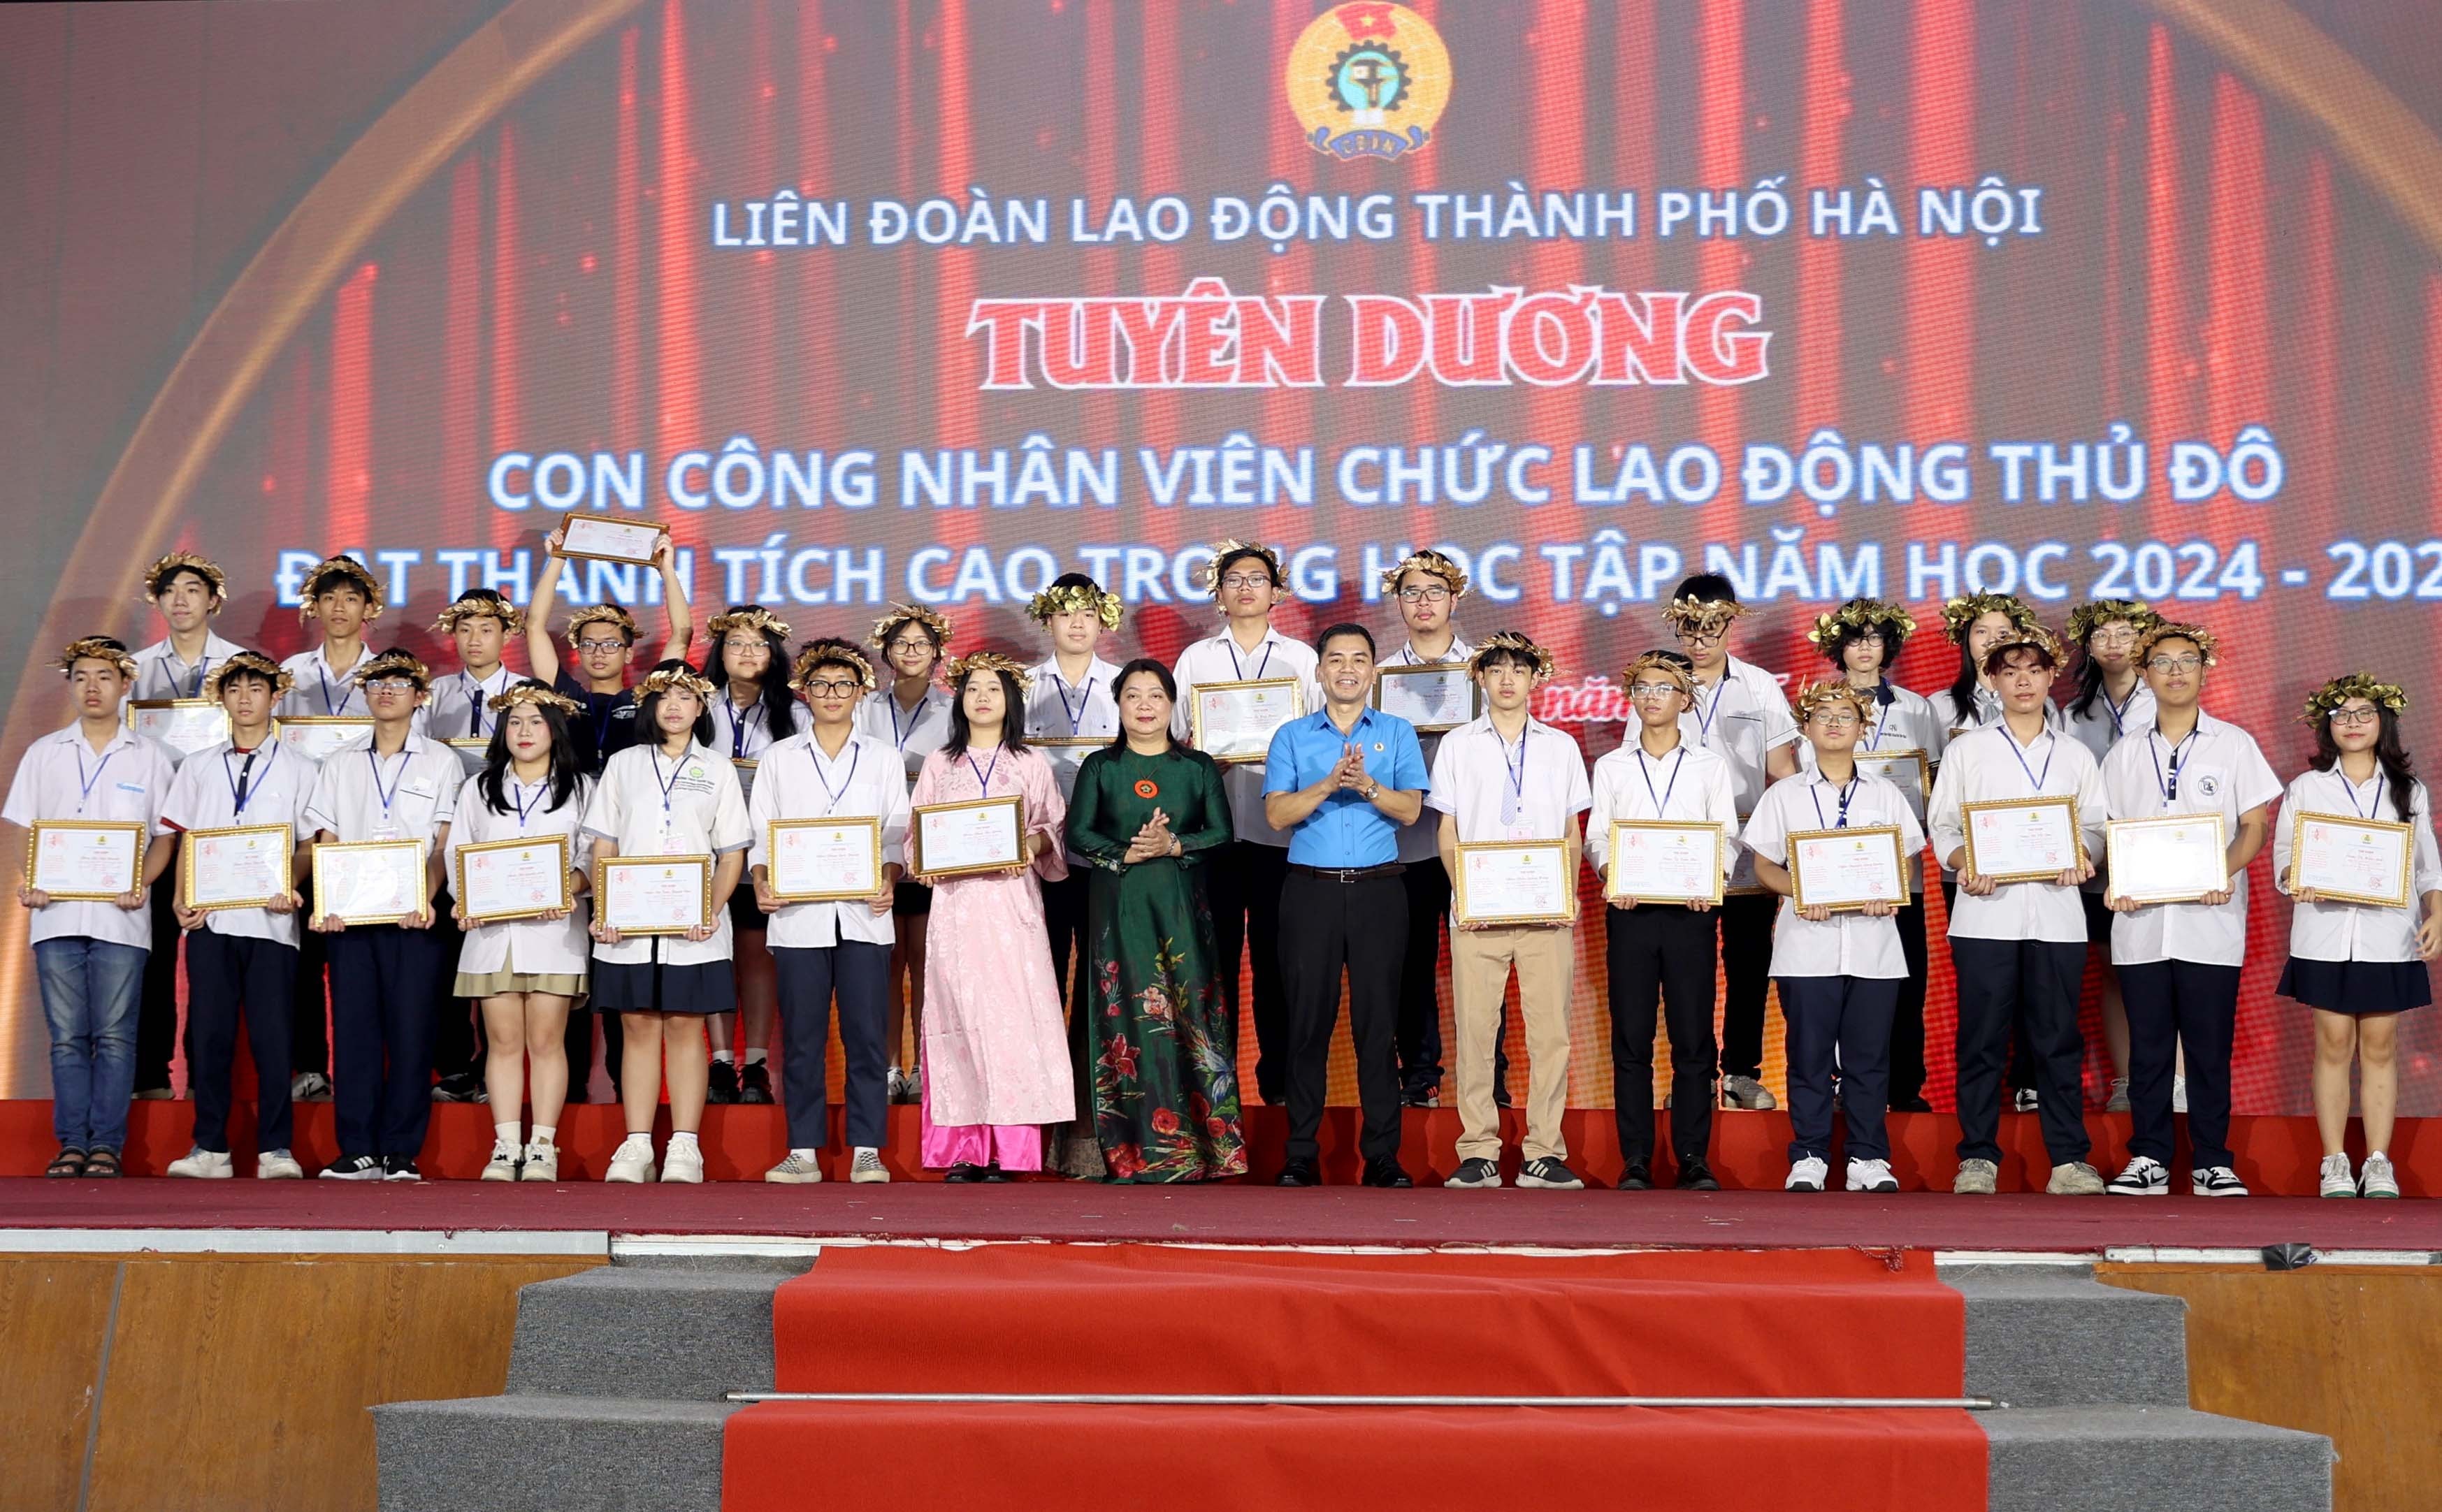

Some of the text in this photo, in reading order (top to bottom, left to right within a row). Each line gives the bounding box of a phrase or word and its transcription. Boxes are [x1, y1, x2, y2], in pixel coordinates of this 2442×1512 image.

[714, 176, 2042, 253] LIÊN ĐOÀN LAO ĐỘNG THÀNH PHỐ HÀ NỘI
[965, 276, 1774, 391] TUYÊN DƯƠNG
[491, 424, 2283, 516] CON CÔNG NHÂN VIÊN CHỨC LAO ĐỘNG THỦ ĐÔ
[275, 551, 419, 605] ĐT
[716, 533, 882, 604] TÍCH
[908, 547, 1057, 603] CAO
[1078, 545, 1338, 602] TROG
[1364, 545, 1522, 601] HC
[1540, 529, 1680, 616] TẬP
[1704, 528, 1880, 599] NĂM
[2090, 543, 2264, 598] 2024
[2283, 569, 2306, 583] -
